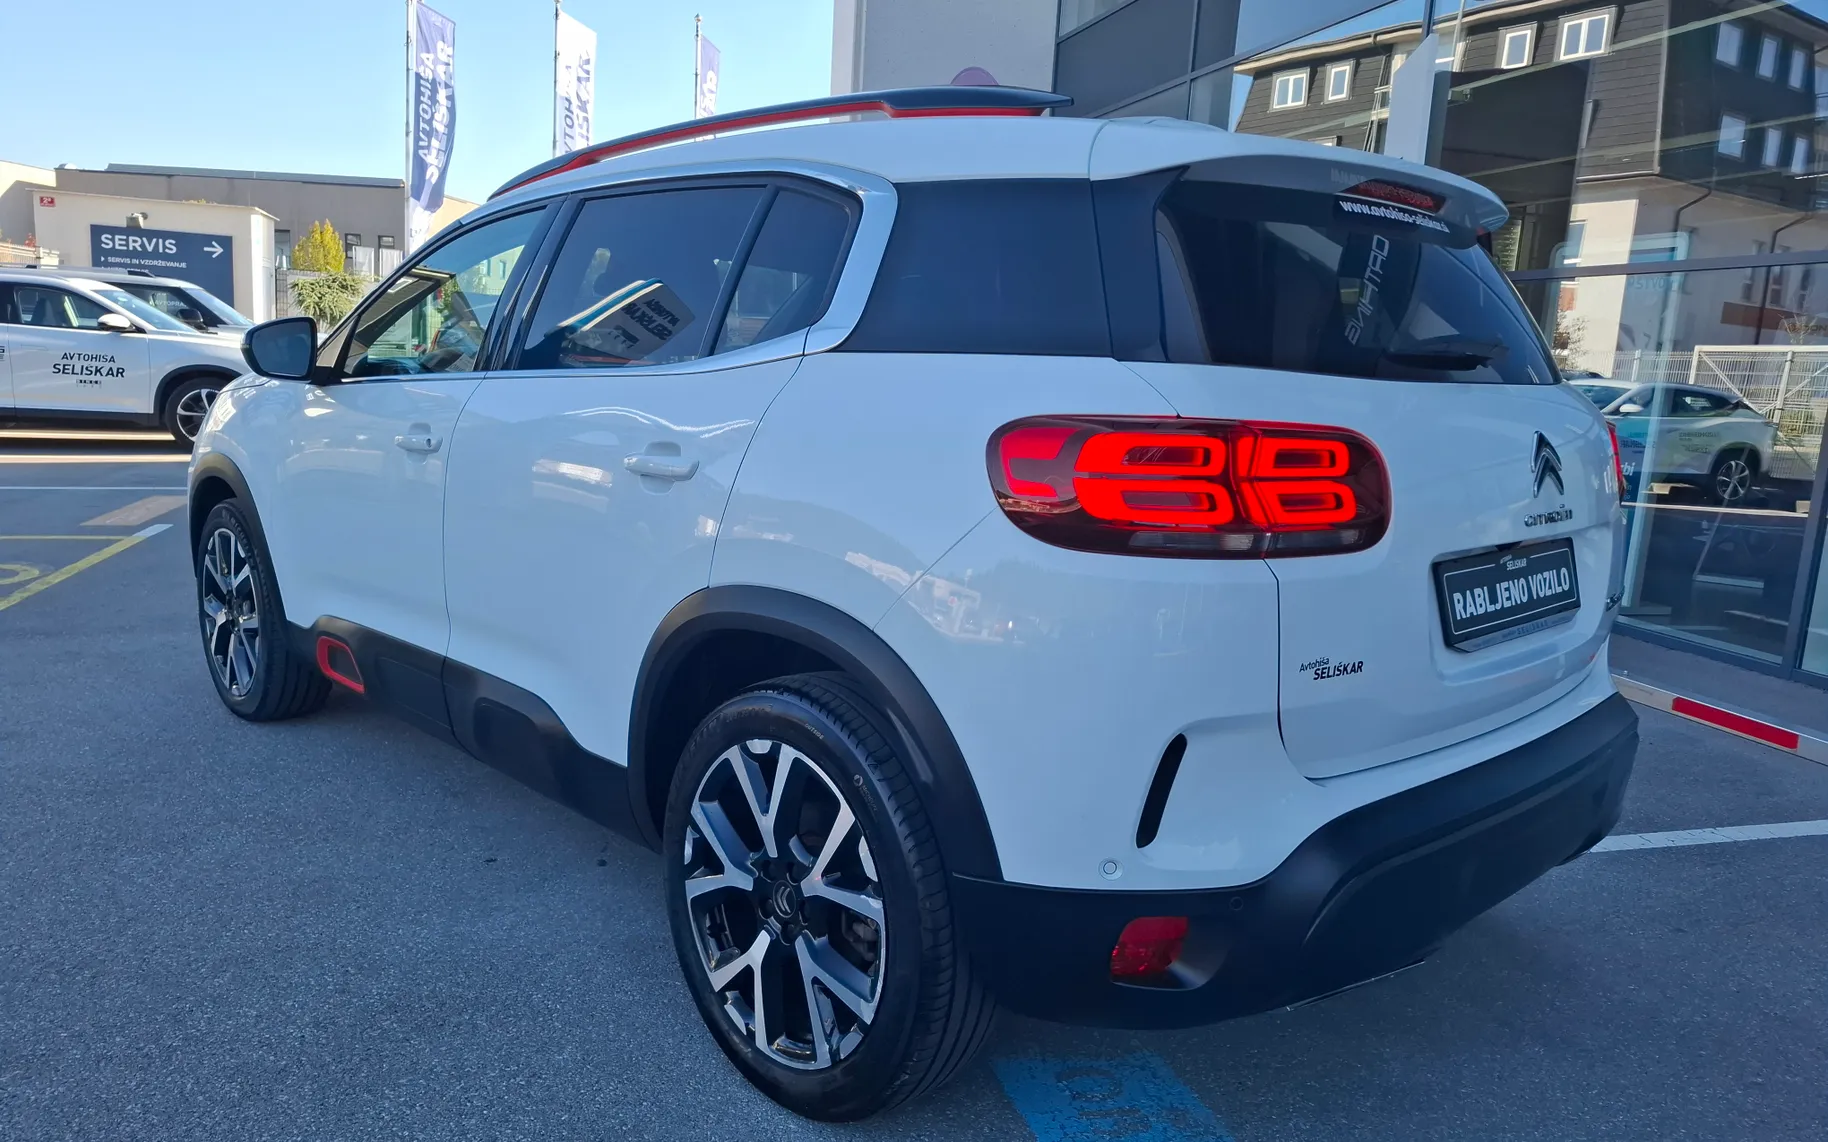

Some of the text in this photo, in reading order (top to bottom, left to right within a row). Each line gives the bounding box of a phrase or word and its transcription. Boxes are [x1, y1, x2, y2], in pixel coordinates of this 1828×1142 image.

[100, 233, 177, 254] SERVIS
[107, 256, 131, 264] SERVIS
[140, 259, 187, 269] VZDRŽEVANJE
[1453, 567, 1570, 620] RABLJENO VOZILO
